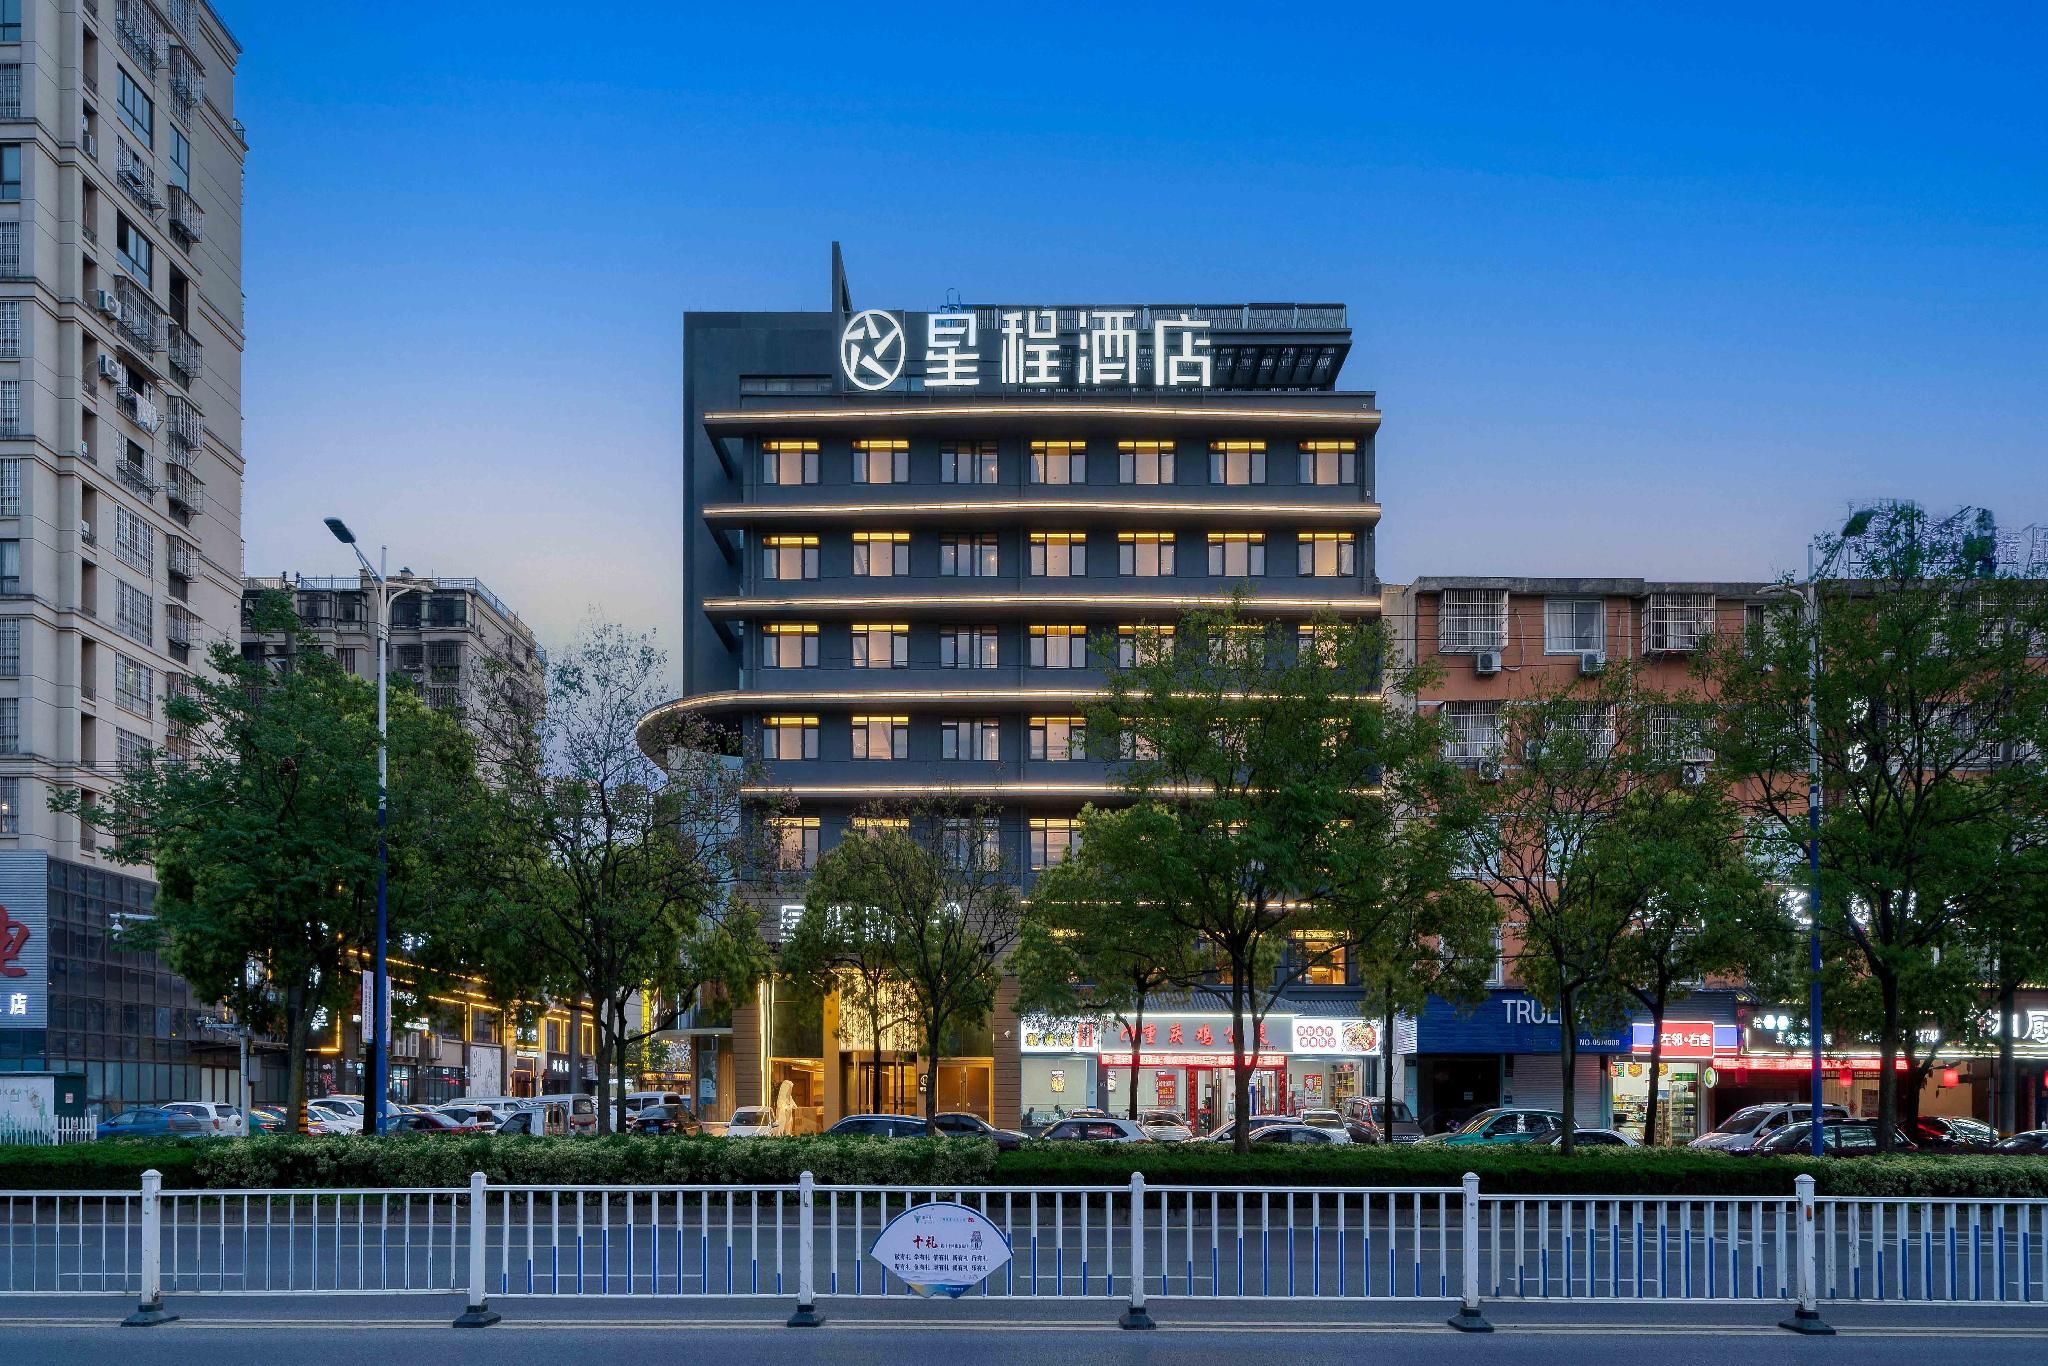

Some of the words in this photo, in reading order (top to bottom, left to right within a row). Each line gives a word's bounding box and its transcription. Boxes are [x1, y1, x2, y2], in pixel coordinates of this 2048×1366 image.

[924, 309, 1211, 387] 星程酒店
[912, 1234, 938, 1250] 十礼
